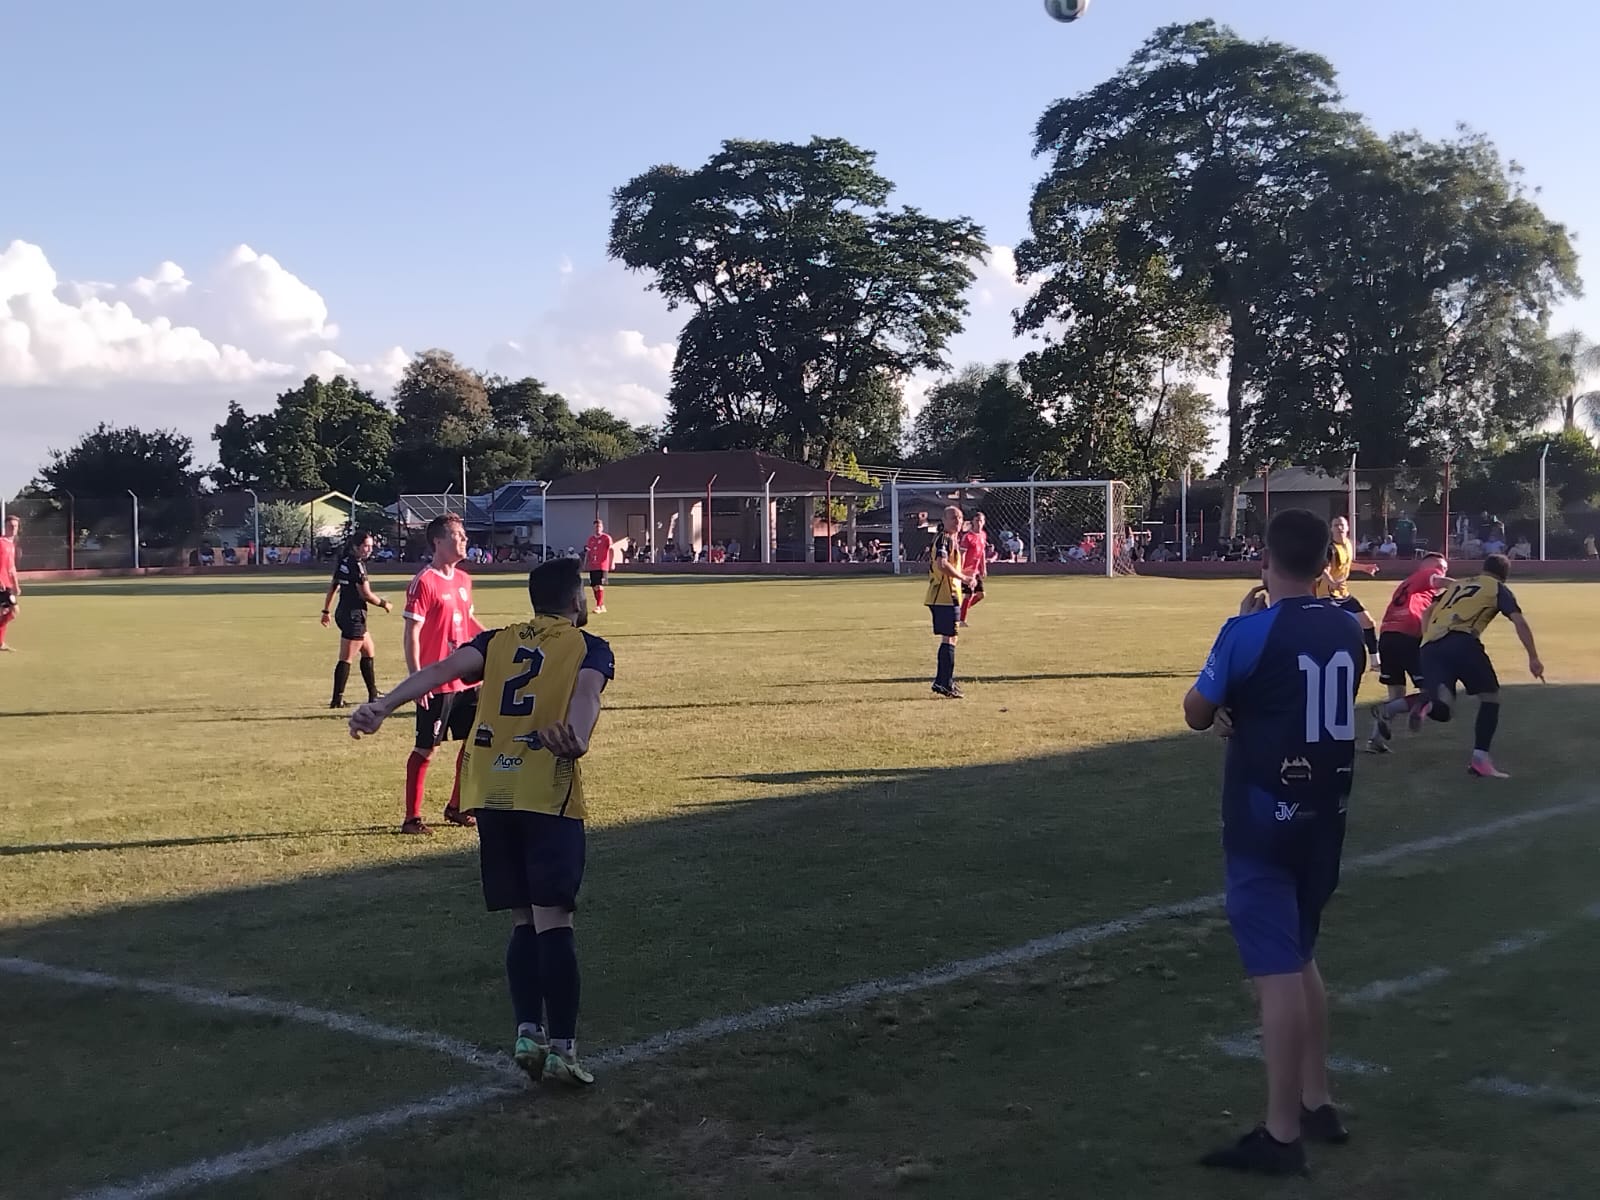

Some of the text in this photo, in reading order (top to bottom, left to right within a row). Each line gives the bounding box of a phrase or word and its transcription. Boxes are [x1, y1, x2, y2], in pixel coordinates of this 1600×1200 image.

[499, 645, 545, 717] 2
[1297, 651, 1355, 743] 10
[493, 753, 524, 769] Agro
